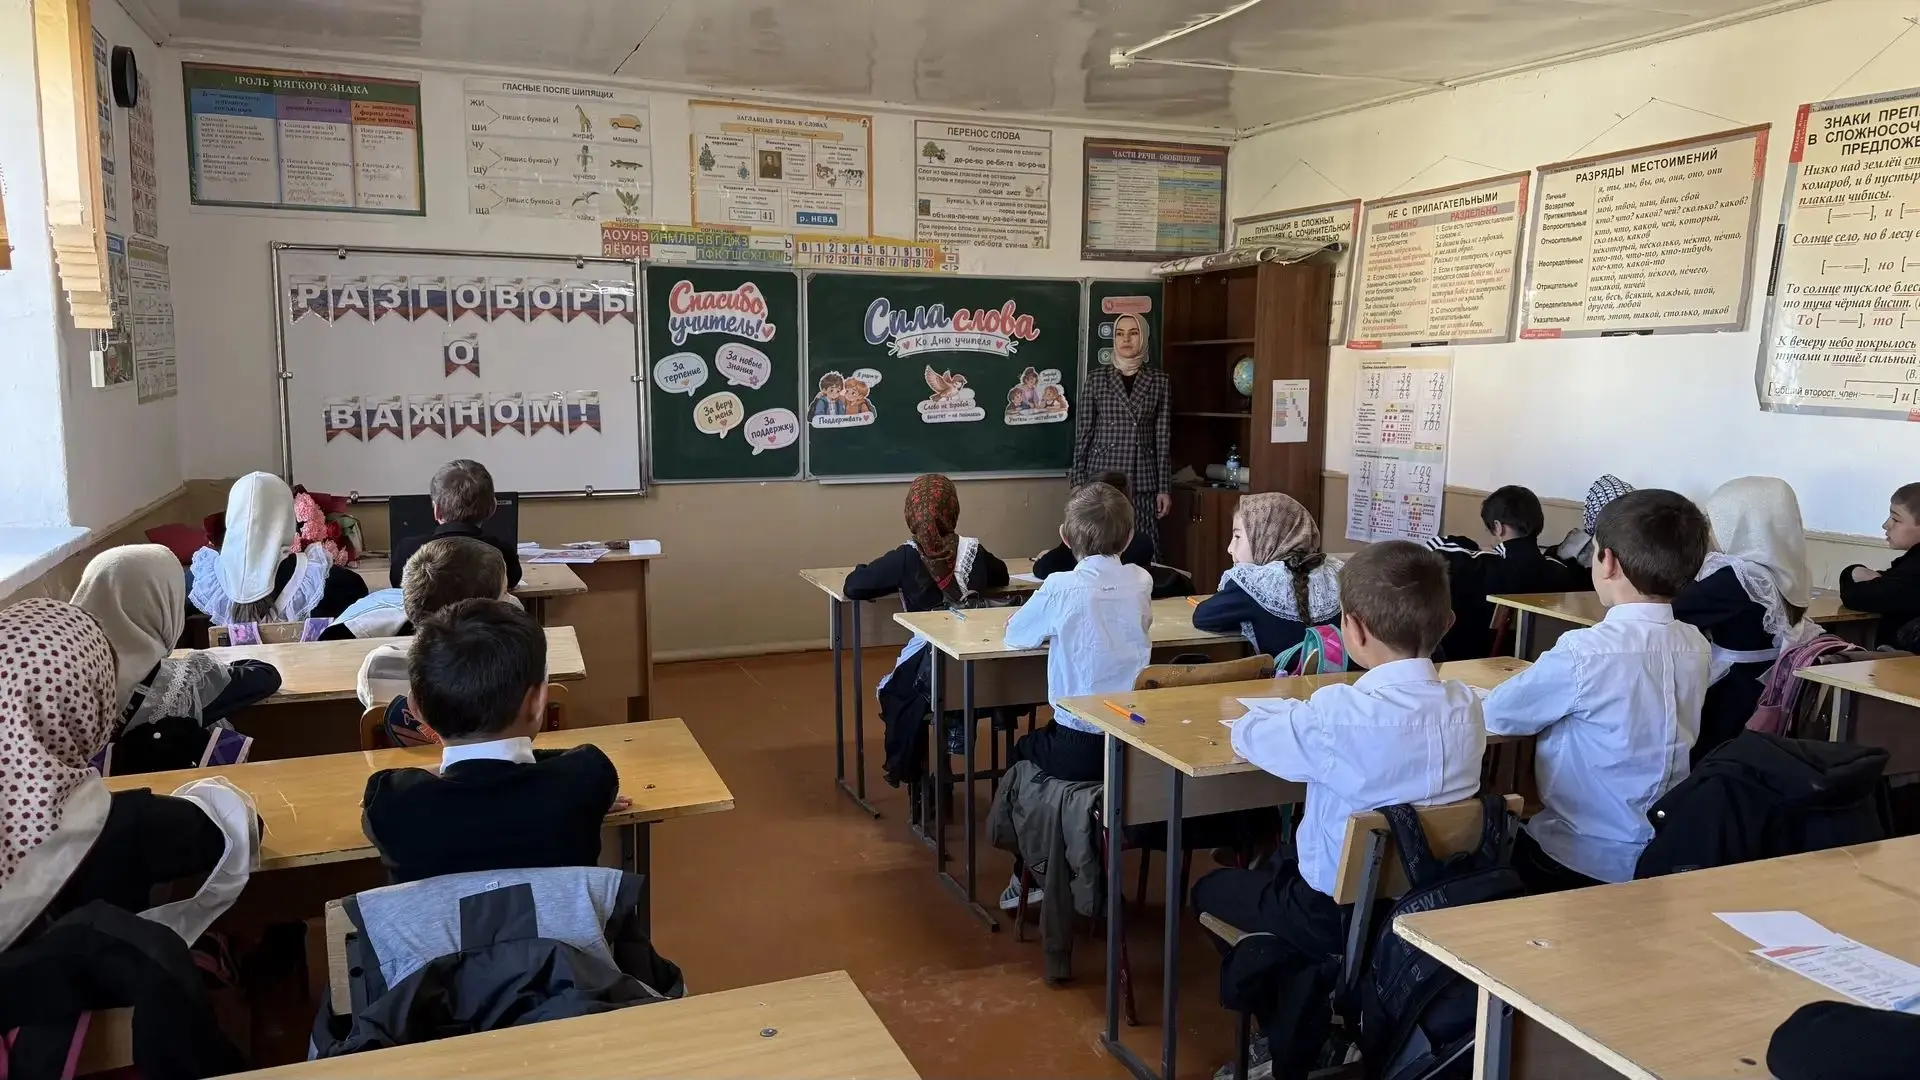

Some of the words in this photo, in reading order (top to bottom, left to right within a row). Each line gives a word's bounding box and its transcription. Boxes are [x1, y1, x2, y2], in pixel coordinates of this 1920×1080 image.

[273, 79, 327, 91] МЯГКОГО
[330, 84, 369, 95] ЗНАКА
[502, 83, 540, 92] ГЛАСНЫЕ
[543, 86, 570, 95] ПОСЛЕ
[572, 88, 614, 99] ШИПЯЩИХ
[1824, 112, 1870, 130] ЗНАКИ
[1878, 105, 1920, 122] ПРЕП
[572, 132, 594, 140] жираф
[948, 127, 988, 138] ПЕРЕНОС
[991, 130, 1020, 140] СЛОВА
[1808, 134, 1817, 145] В
[1113, 151, 1136, 159] ЧАСТИ
[1576, 166, 1624, 183] РАЗРЯДЫ
[1631, 147, 1718, 174] МЕСТОИМЕНИЙ
[1804, 164, 1837, 176] Низко
[1841, 160, 1860, 172] над
[1863, 155, 1901, 170] землёй
[1669, 173, 1685, 181] она,
[1707, 167, 1722, 175] они
[1802, 176, 1852, 191] комаров,
[1855, 178, 1862, 186] и
[1865, 174, 1871, 184] в
[1597, 195, 1614, 203] себя
[1681, 192, 1700, 202] свой
[1799, 193, 1845, 205] плакали
[1848, 189, 1891, 202] чибисы.
[1388, 210, 1398, 219] НЕ
[1402, 208, 1407, 216] С
[1413, 192, 1497, 214] ПРИЛАГАТЕЛЬНЫМИ
[1545, 201, 1575, 210] Возвратное
[1596, 215, 1614, 224] кто?
[1616, 212, 1635, 222] что?
[1635, 209, 1662, 219] какой?
[1664, 206, 1681, 215] чей?
[1682, 201, 1718, 213] сколько?
[1720, 196, 1749, 208] каков?
[762, 212, 772, 220] 41
[1451, 206, 1498, 220] РАЗДЕЛЬНО
[1544, 209, 1587, 221] Притяжательные
[1255, 223, 1291, 234] ПУНКТУАЦИЯ
[1301, 216, 1335, 227] СЛОЖНЫХ
[1296, 221, 1351, 238] СОЧИНИТЕЛЬНОЙ
[1542, 221, 1587, 231] Вопросительные
[1541, 235, 1582, 245] Относительные
[1793, 232, 1833, 245] Солнце
[1835, 232, 1860, 242] село,
[1863, 232, 1877, 241] но
[1880, 228, 1887, 239] в
[1888, 229, 1913, 242] лесу
[802, 243, 807, 251] 0
[817, 243, 820, 252] 1
[829, 244, 835, 252] 2
[842, 244, 847, 253] 3
[854, 245, 859, 253] 4
[868, 245, 872, 254] 5
[880, 246, 885, 254] 6
[892, 246, 897, 255] 7
[904, 247, 909, 256] 8
[915, 248, 920, 256] 9
[925, 248, 934, 257] 10
[814, 255, 820, 263] 11
[825, 255, 834, 264] 12
[838, 255, 847, 264] 13
[851, 256, 859, 265] 14
[863, 257, 872, 266] 15
[876, 257, 884, 266] 16
[889, 258, 896, 267] 17
[900, 258, 909, 267] 18
[912, 259, 920, 268] 19
[924, 259, 934, 268] 20
[1537, 282, 1578, 290] Отрицательные
[1786, 283, 1800, 294] То
[1803, 284, 1840, 296] солнце
[1843, 282, 1891, 297] тусклое
[1893, 281, 1920, 292] блес
[296, 283, 634, 313] РАЗГОВОРЫ
[670, 281, 766, 318] Спасибо,
[1535, 301, 1583, 309] Определительные
[1783, 300, 1799, 309] то
[1803, 300, 1832, 312] туча
[1835, 297, 1871, 311] чёрная
[1874, 297, 1911, 308] висит.
[866, 298, 950, 344] Сила
[953, 301, 1040, 340] слова
[670, 314, 763, 343] учитель!
[916, 336, 927, 347] Ко
[931, 335, 950, 346] Дню
[955, 338, 991, 347] учителя
[1778, 336, 1787, 345] К
[1790, 336, 1826, 349] вечеру
[1829, 336, 1854, 347] небо
[1856, 337, 1916, 351] покрылось
[448, 339, 475, 365] О
[1775, 352, 1821, 363] тучами
[1824, 354, 1830, 362] и
[1832, 352, 1865, 363] пошёл
[1869, 352, 1916, 365] сильный
[672, 362, 685, 372] За
[726, 351, 738, 361] За
[739, 357, 763, 370] новые
[664, 367, 702, 383] терпение
[726, 362, 754, 376] знания
[1804, 389, 1837, 398] второст.
[703, 406, 714, 417] За
[716, 399, 734, 413] веру
[715, 410, 734, 422] меня
[764, 417, 775, 426] За
[751, 421, 795, 440] поддержку
